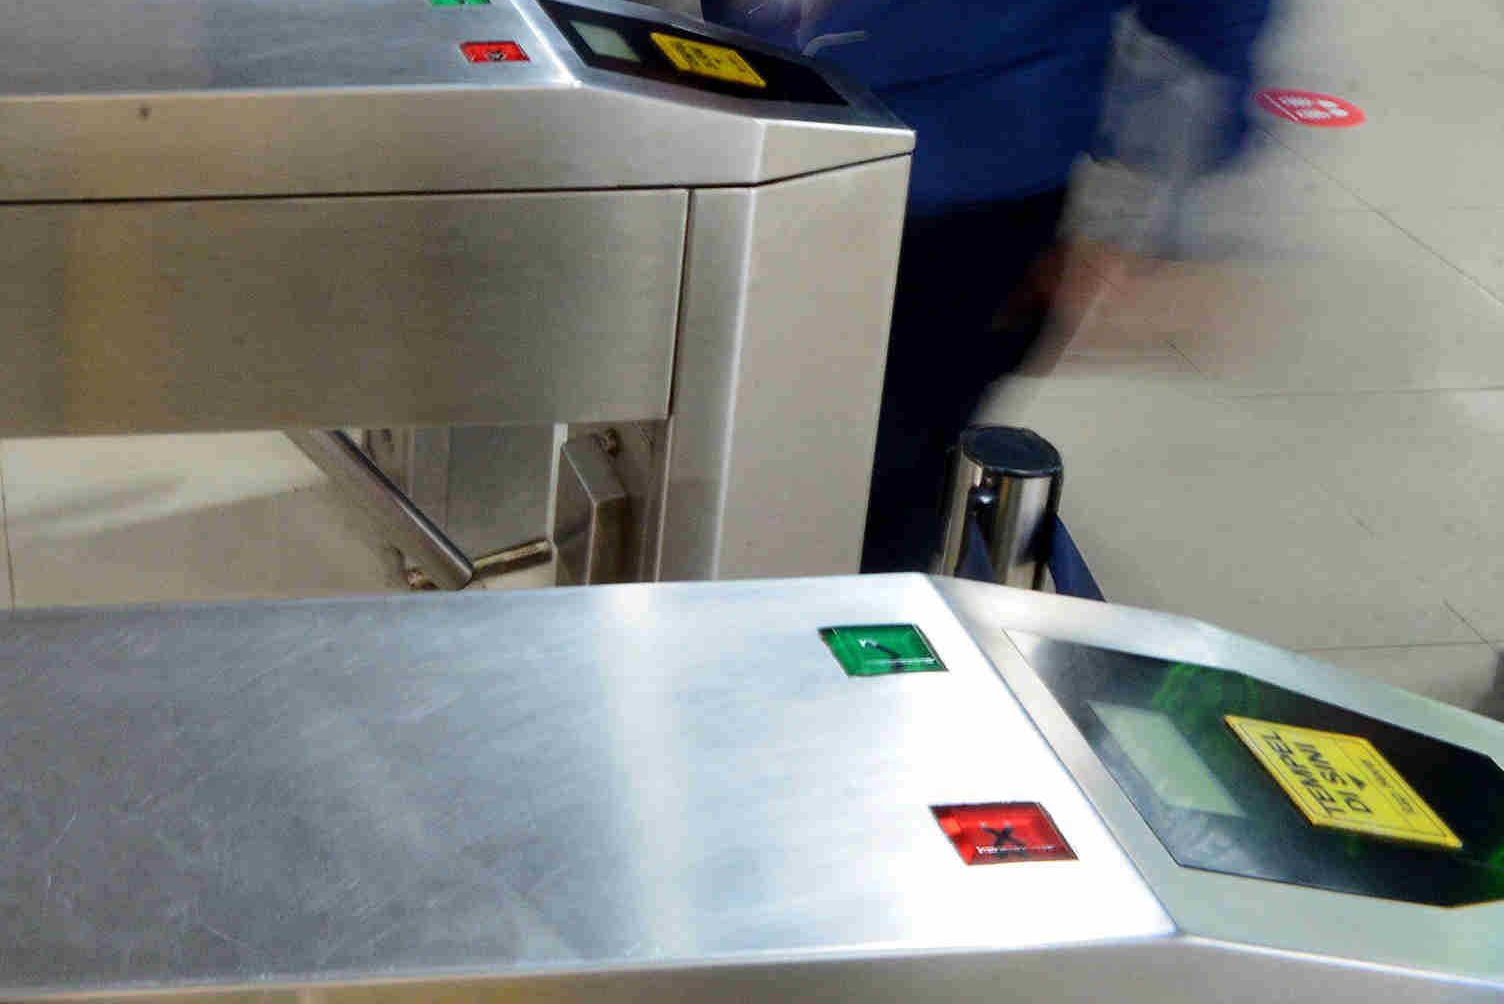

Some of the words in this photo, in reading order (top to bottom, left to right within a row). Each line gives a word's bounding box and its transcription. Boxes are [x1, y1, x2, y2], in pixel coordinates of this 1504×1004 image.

[1263, 732, 1346, 816] TEMPEL
[1293, 741, 1347, 787] SINI
[1337, 789, 1373, 815] DI
